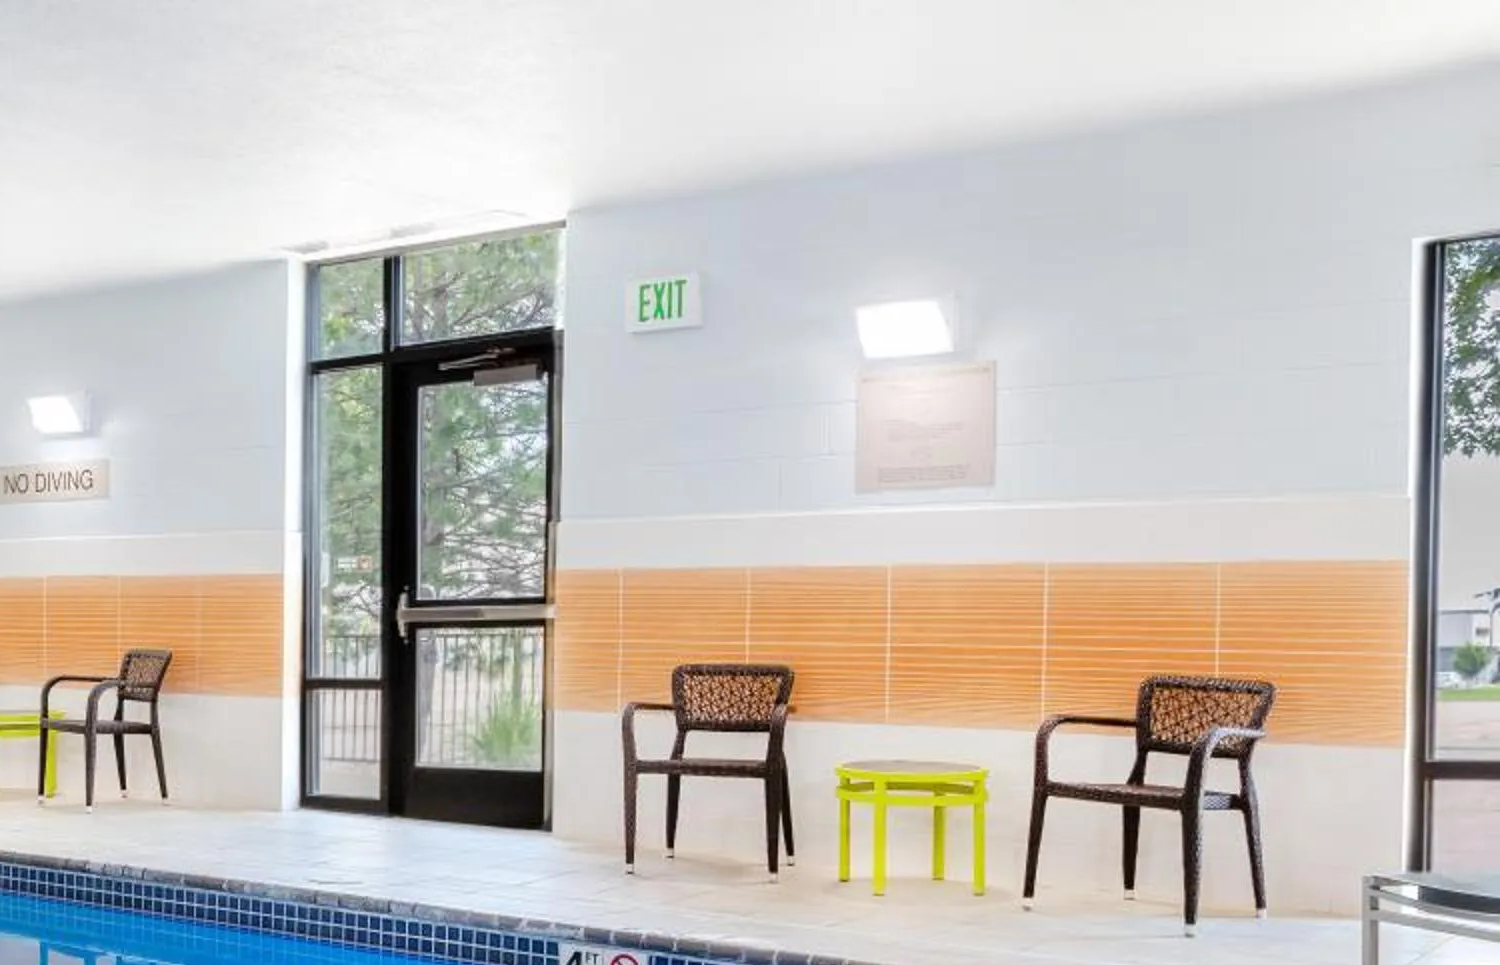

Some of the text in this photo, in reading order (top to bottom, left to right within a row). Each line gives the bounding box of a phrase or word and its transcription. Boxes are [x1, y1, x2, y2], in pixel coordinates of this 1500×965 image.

[638, 279, 687, 322] EXIT
[3, 469, 93, 494] NO DIVING
[585, 952, 601, 965] FT
